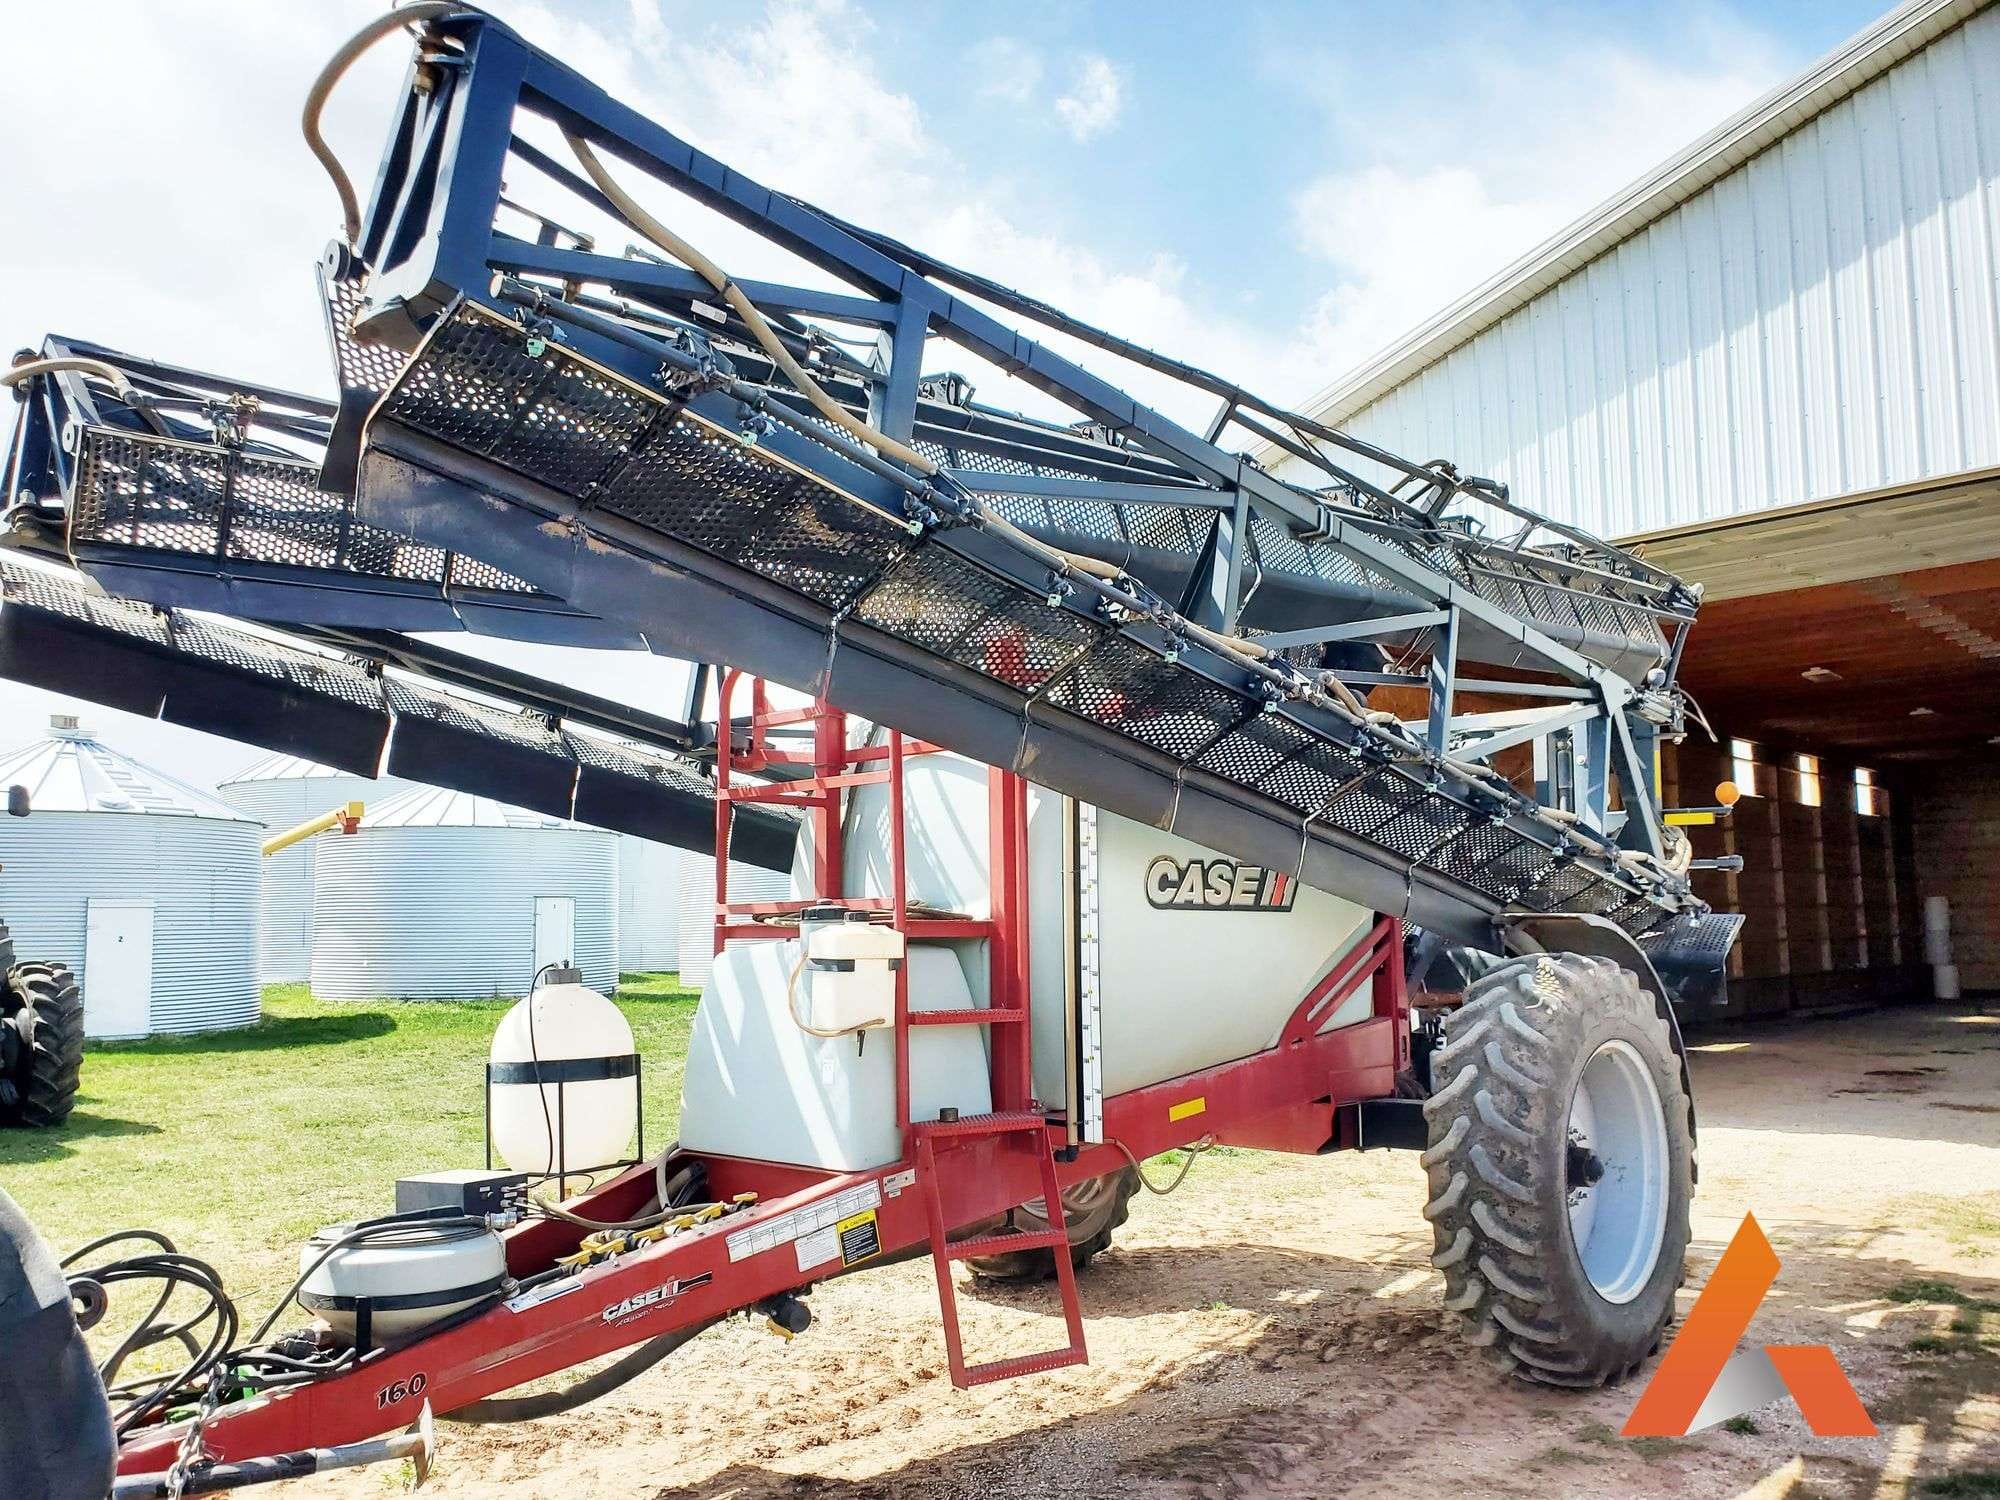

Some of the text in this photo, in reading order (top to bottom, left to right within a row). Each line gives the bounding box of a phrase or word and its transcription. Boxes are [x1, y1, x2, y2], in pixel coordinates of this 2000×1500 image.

[1147, 860, 1262, 906] CASE
[602, 1289, 661, 1321] CASE
[376, 1371, 427, 1409] 160
